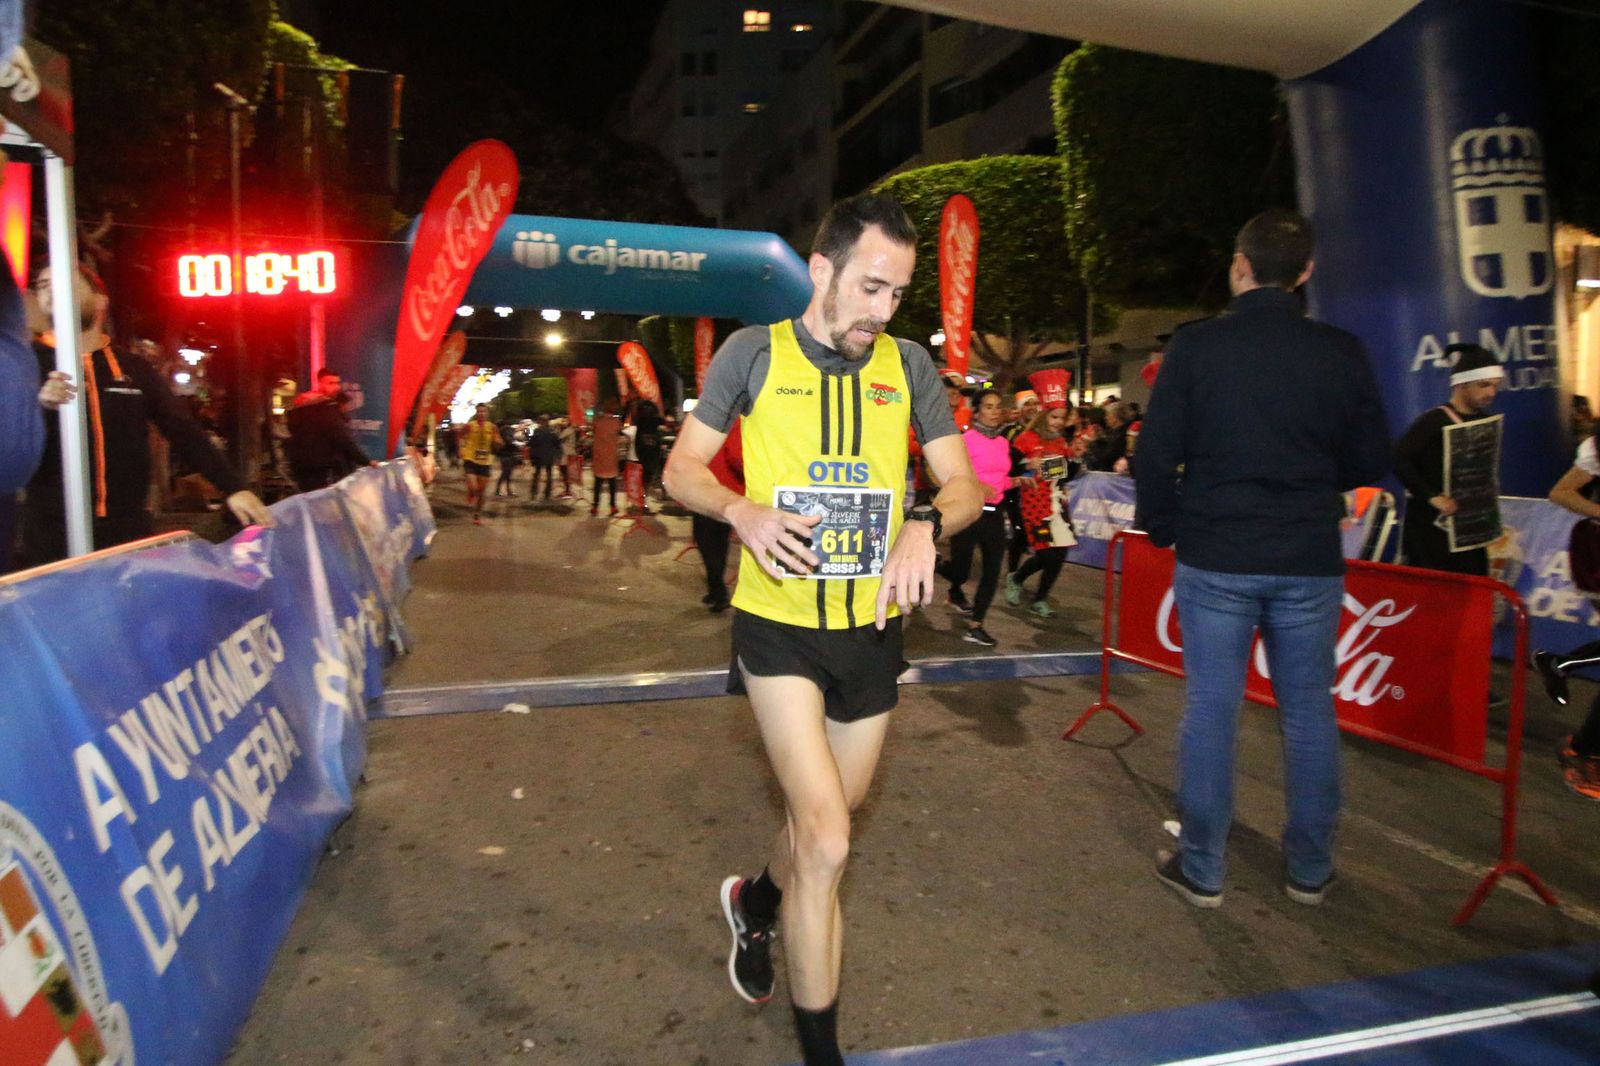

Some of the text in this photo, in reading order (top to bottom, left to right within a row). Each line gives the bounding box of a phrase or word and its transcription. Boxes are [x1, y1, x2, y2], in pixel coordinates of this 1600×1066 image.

[567, 239, 707, 275] cajamar
[808, 461, 869, 483] OTIS
[821, 529, 863, 554] 611
[73, 610, 285, 853] AYUNTAMIEO
[120, 830, 200, 976] DE
